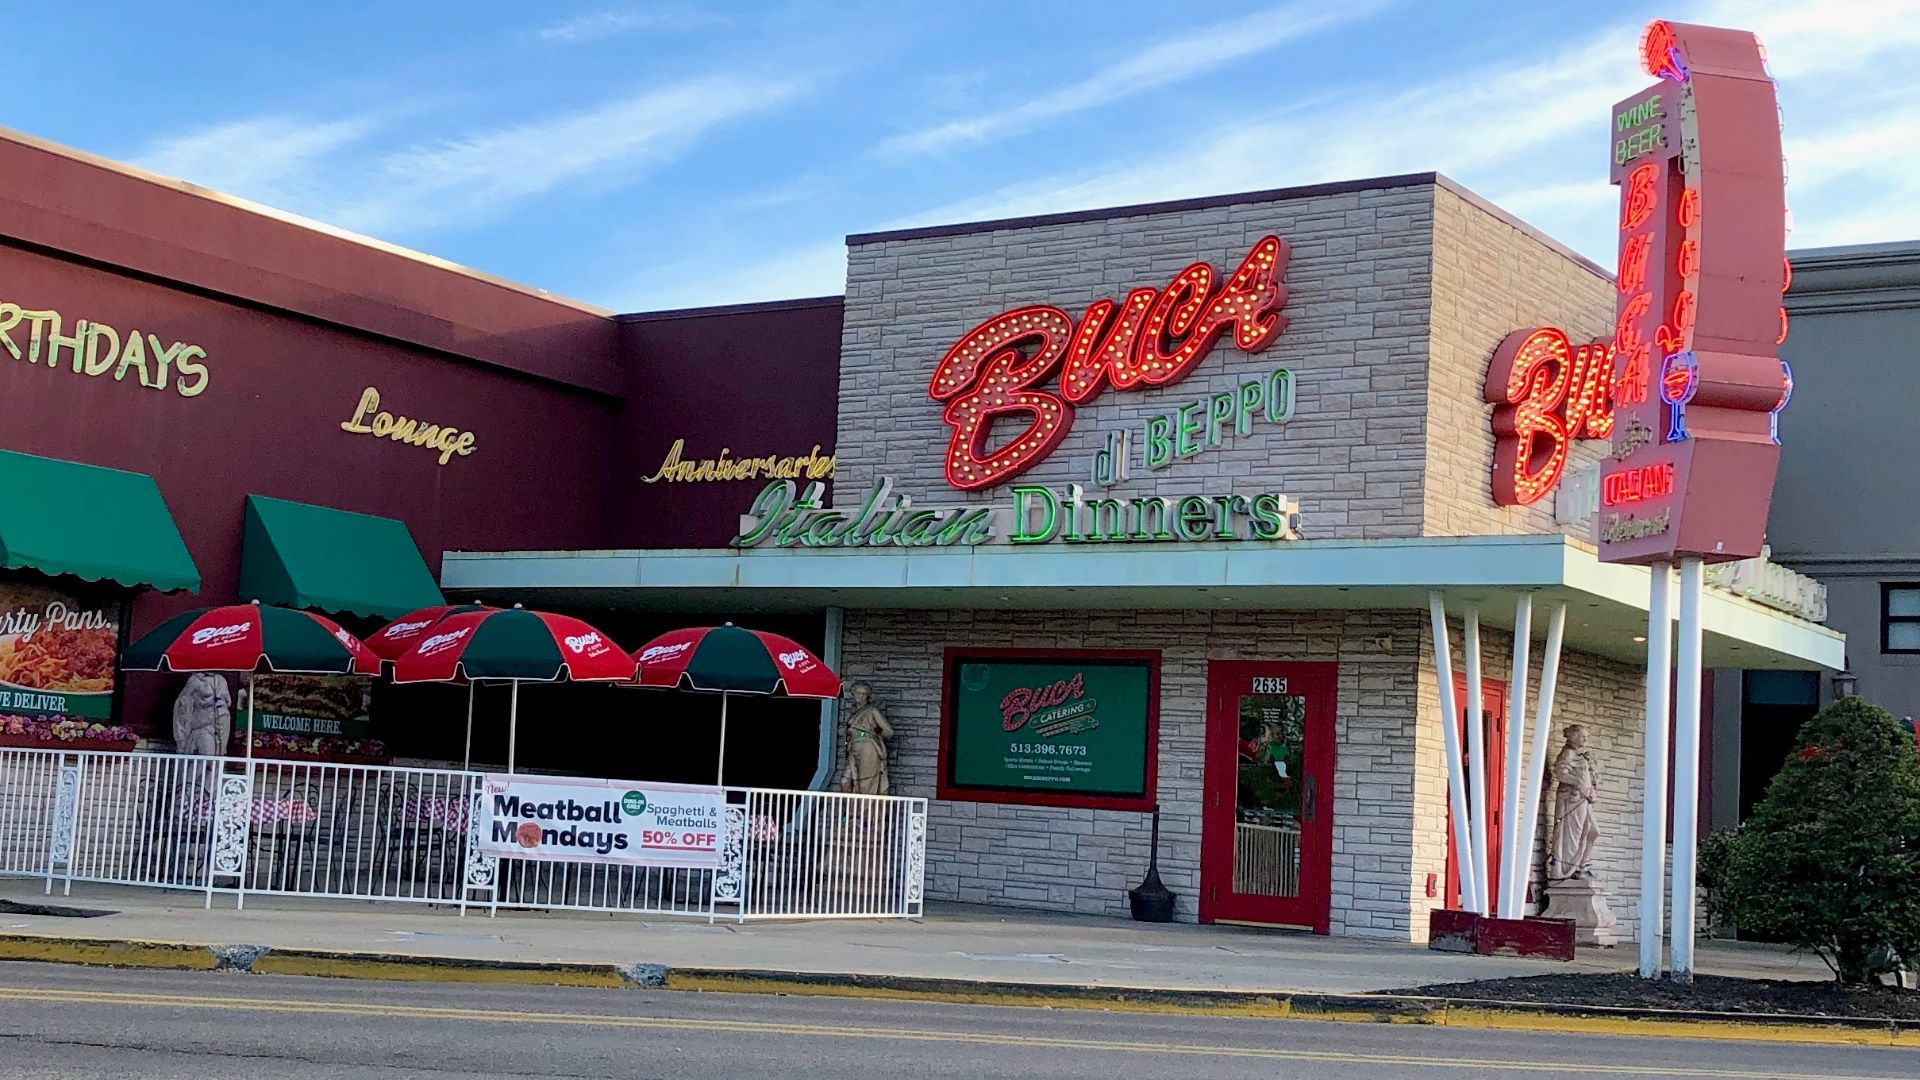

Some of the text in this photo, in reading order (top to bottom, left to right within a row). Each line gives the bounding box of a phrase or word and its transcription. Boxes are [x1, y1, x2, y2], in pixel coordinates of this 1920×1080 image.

[1617, 94, 1664, 132] WINE
[1615, 124, 1665, 165] BEER
[0, 303, 209, 397] RTHDAYS
[341, 386, 477, 465] Lounge
[1145, 368, 1296, 471] BEPPO
[1488, 327, 1616, 505] BU
[641, 439, 838, 484] Anniversaries
[734, 477, 1289, 547] Italian Dinners
[46, 601, 111, 631] Pans.
[1254, 678, 1286, 693] 2635
[13, 692, 68, 712] DELIVER.
[1040, 703, 1085, 724] CATERING
[263, 714, 342, 734] WELCOME HERE.
[1010, 743, 1087, 756] 513.396.7673
[485, 781, 510, 795] New!
[493, 795, 622, 824] Meatball
[647, 803, 718, 818] Spaghetti &
[656, 817, 717, 829] Meatballs
[642, 831, 716, 846] 50% OFF
